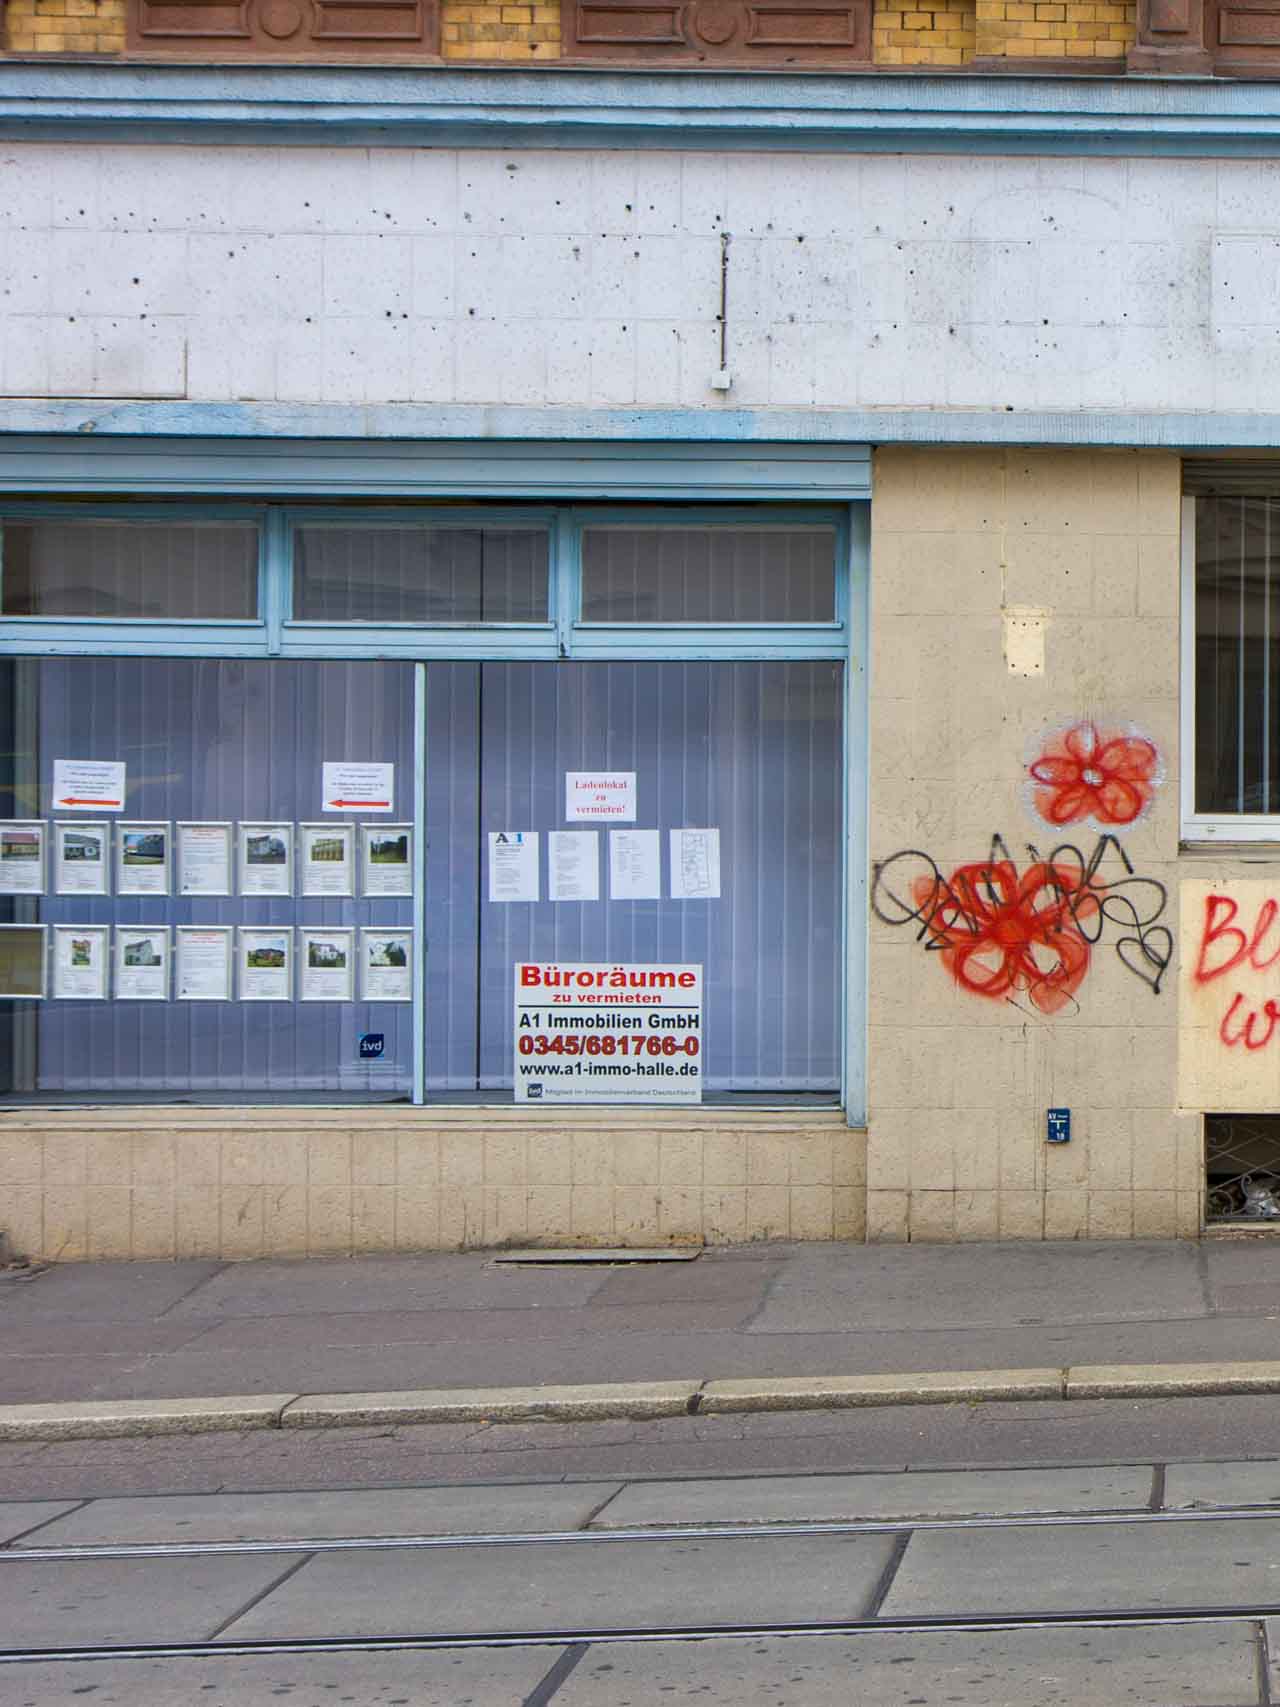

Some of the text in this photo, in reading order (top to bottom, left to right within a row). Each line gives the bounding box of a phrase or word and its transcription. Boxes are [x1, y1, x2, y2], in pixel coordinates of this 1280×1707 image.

[575, 780, 627, 790] Ladenlokal
[575, 804, 625, 814] vermieten!
[520, 966, 696, 988] Büroräume
[552, 992, 662, 1004] zu vermieten
[519, 1013, 700, 1029] A1 Immobilien GmbH
[361, 1039, 383, 1051] ivd
[518, 1035, 700, 1056] 0345/681766-0
[519, 1062, 699, 1077] www.a1-immo-halle.de
